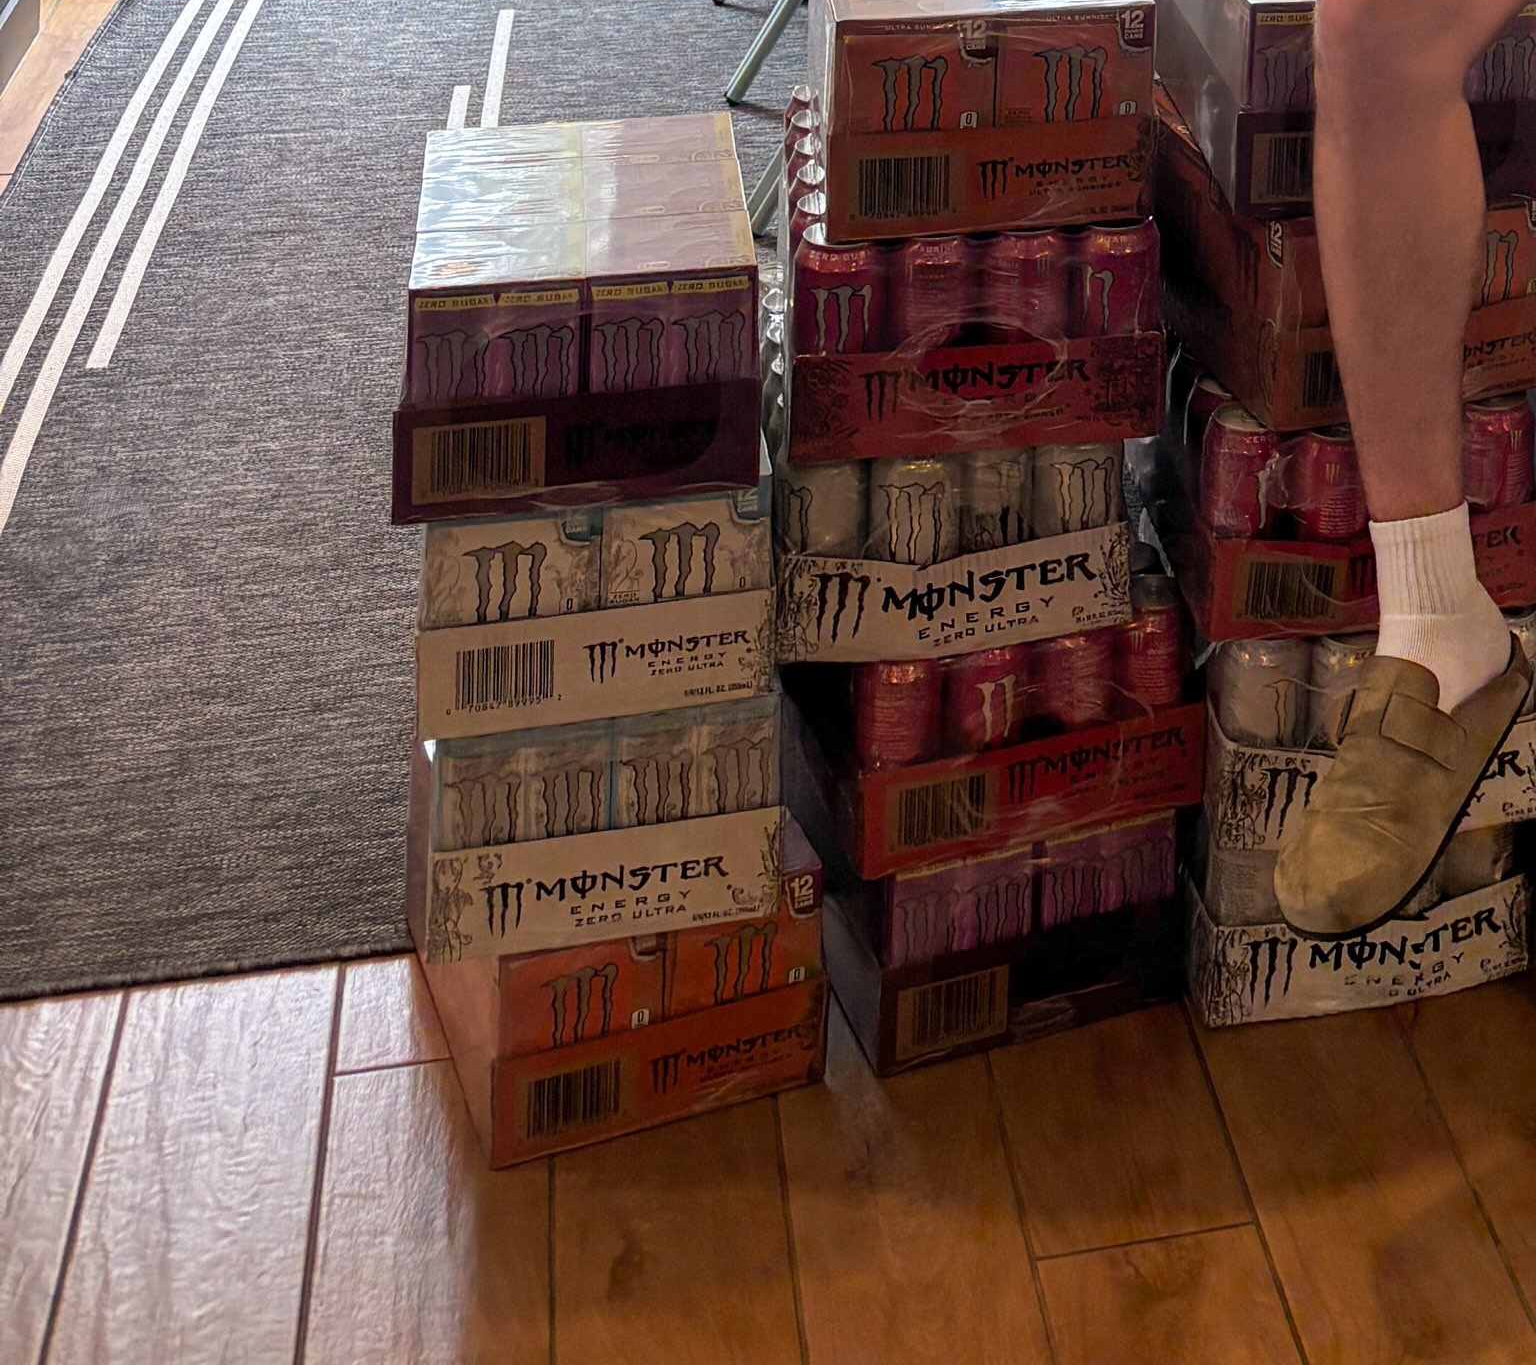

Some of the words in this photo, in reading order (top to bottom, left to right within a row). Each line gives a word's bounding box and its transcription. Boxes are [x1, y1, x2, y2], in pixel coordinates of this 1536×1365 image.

[964, 20, 987, 38] 12
[1121, 10, 1145, 29] 12
[1015, 155, 1131, 180] MONSTER
[1463, 331, 1534, 361] ONSTER
[910, 358, 1091, 392] MONSTER
[882, 551, 1098, 622] MONSTER
[918, 595, 1054, 641] ENERGY
[932, 626, 975, 647] ZERO
[985, 615, 1040, 634] ULTRA
[625, 630, 751, 659] MONSTER
[648, 651, 726, 668] ENERGY
[650, 666, 682, 676] ZERO
[688, 660, 724, 671] ULTRA
[1043, 726, 1185, 775] MONSTER
[536, 855, 729, 903] MONSTER
[790, 874, 814, 898] 12
[570, 889, 691, 915] ENERGY
[574, 913, 622, 927] ZERO
[632, 904, 687, 920] ULTRA
[686, 1027, 800, 1068] MONSTER
